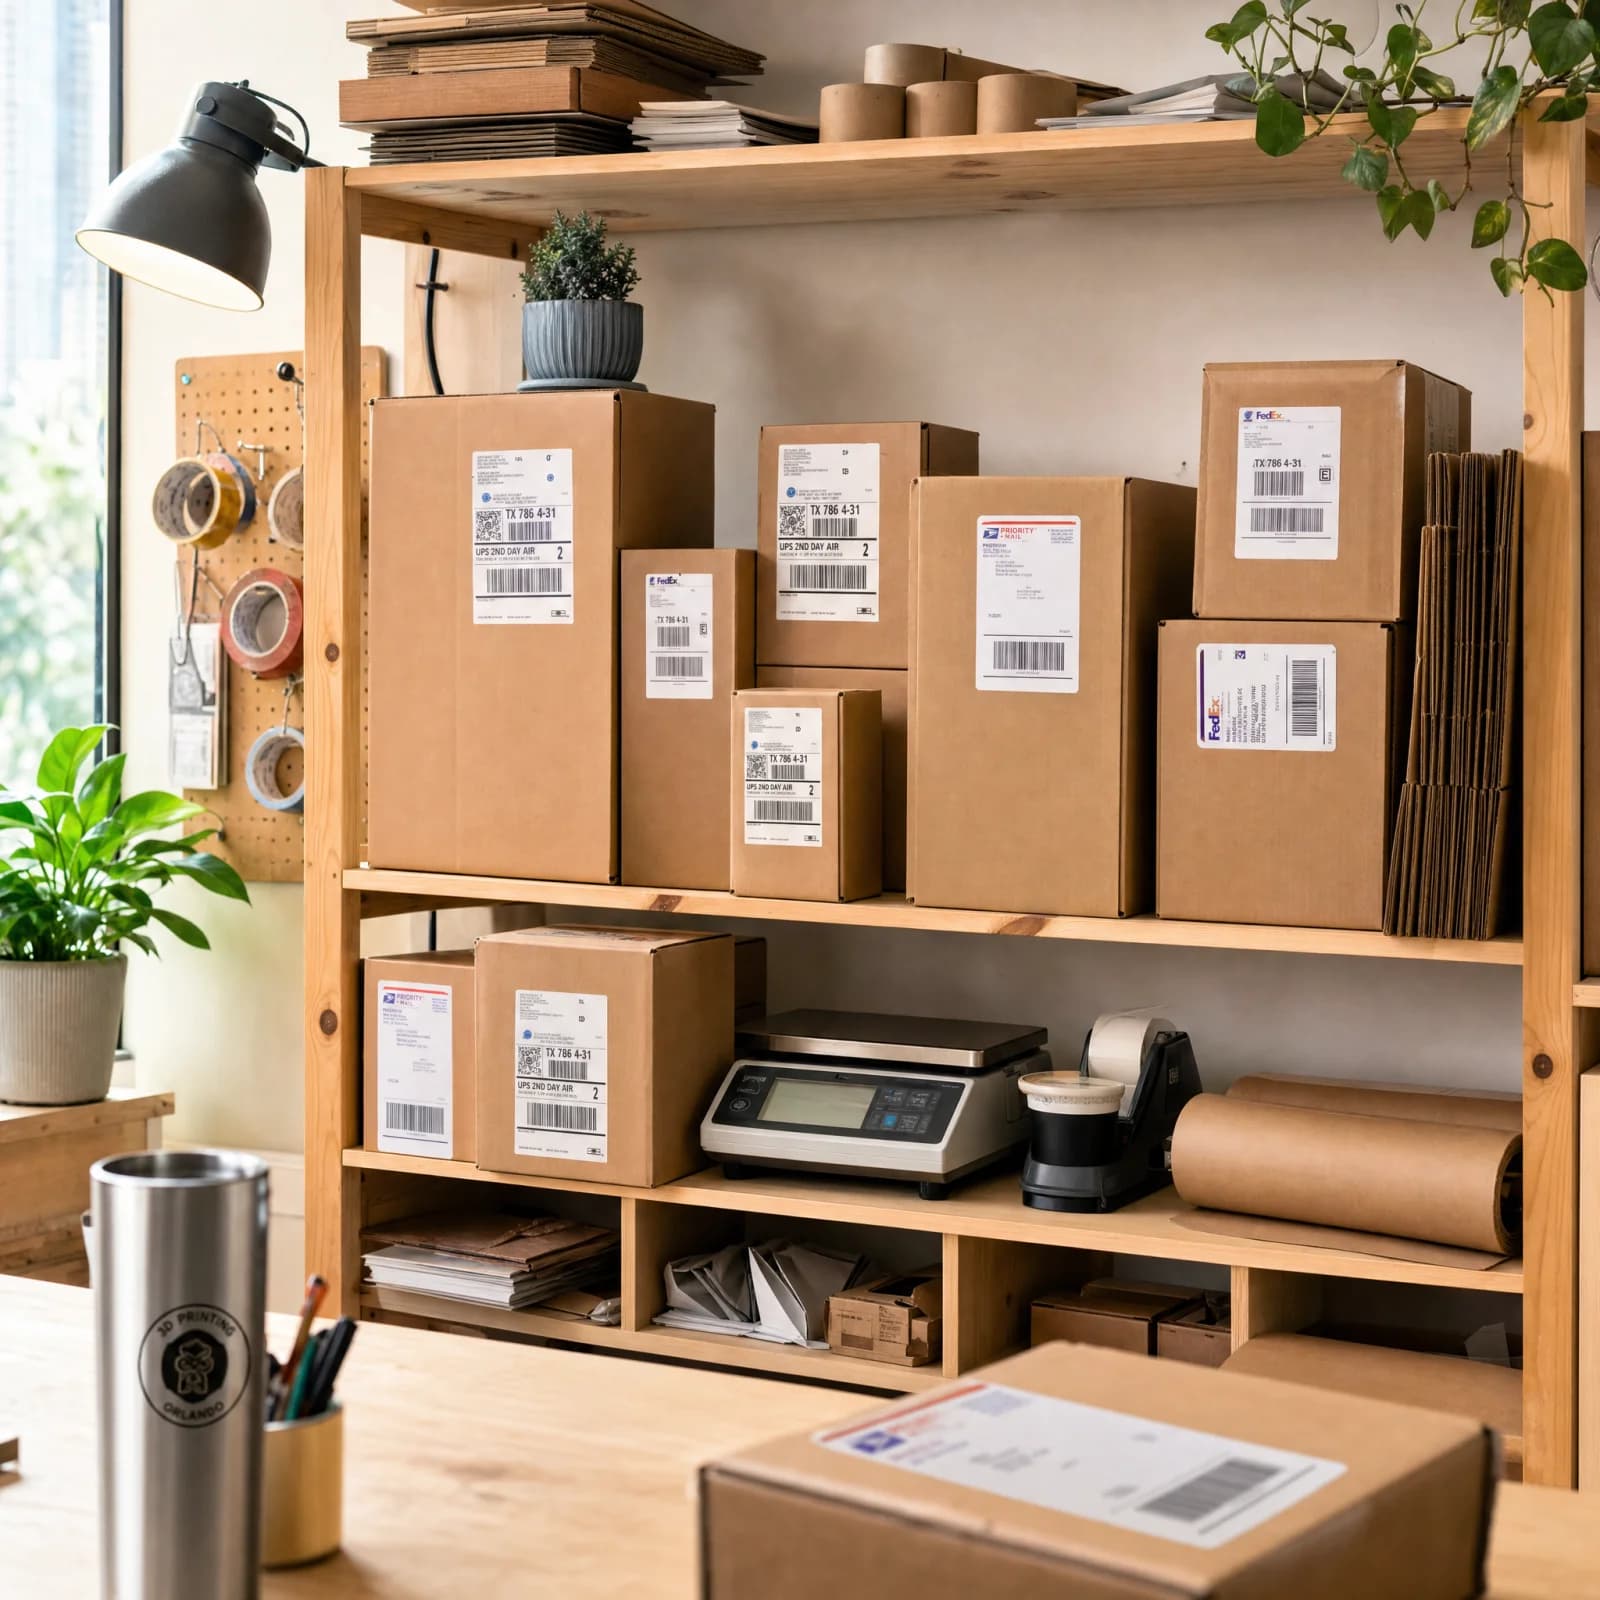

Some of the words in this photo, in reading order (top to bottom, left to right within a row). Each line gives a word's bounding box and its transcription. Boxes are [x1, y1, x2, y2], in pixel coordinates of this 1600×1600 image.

[1256, 411, 1281, 420] FedEx
[1255, 459, 1265, 467] TX
[1267, 459, 1281, 467] 786
[1284, 459, 1301, 467] 4-31
[506, 509, 516, 519] TX
[519, 508, 533, 518] 786
[537, 508, 555, 518] 4-31
[810, 505, 820, 515] TX
[824, 505, 838, 515] 786
[841, 505, 860, 515] 4-31
[476, 548, 489, 556] UPS
[507, 547, 521, 555] DAY
[523, 547, 535, 555] AIR
[557, 547, 563, 560] 2
[863, 544, 868, 557] 2
[1208, 699, 1220, 740] FedEx
[770, 755, 777, 763] TX
[780, 755, 791, 763] 786
[793, 755, 807, 763] 4-31
[809, 785, 813, 795] 2
[397, 993, 422, 1001] PRIORITY
[546, 1048, 555, 1057] TX
[558, 1049, 571, 1058] 786
[574, 1050, 591, 1060] 4-31
[518, 1081, 531, 1089] UPS
[532, 1082, 545, 1090] 2ND
[547, 1083, 561, 1091] DAY
[562, 1084, 573, 1092] AIR
[593, 1087, 598, 1100] 2
[177, 1312, 236, 1336] PRINTING
[163, 1402, 224, 1420] ORLANDO
